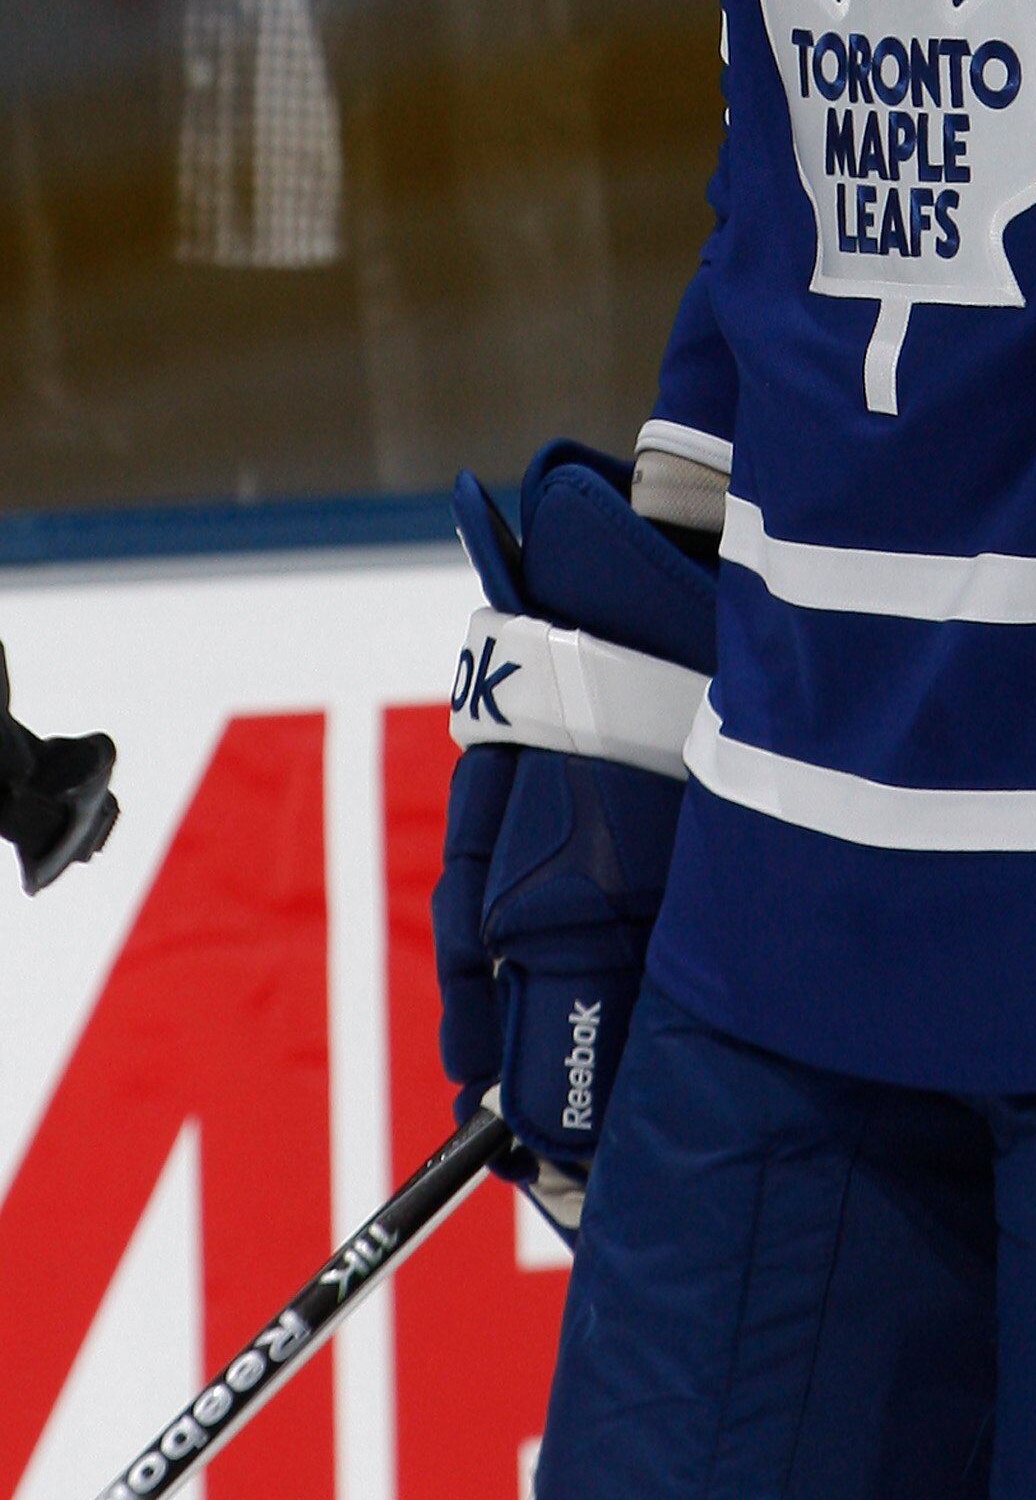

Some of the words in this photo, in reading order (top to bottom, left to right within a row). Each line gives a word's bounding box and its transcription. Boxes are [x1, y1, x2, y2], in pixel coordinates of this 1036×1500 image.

[791, 28, 1022, 110] TORONTO
[825, 107, 970, 183] MAPLE
[837, 183, 961, 259] LEAFS
[562, 998, 602, 1130] Reebok
[318, 1222, 399, 1303] 11K
